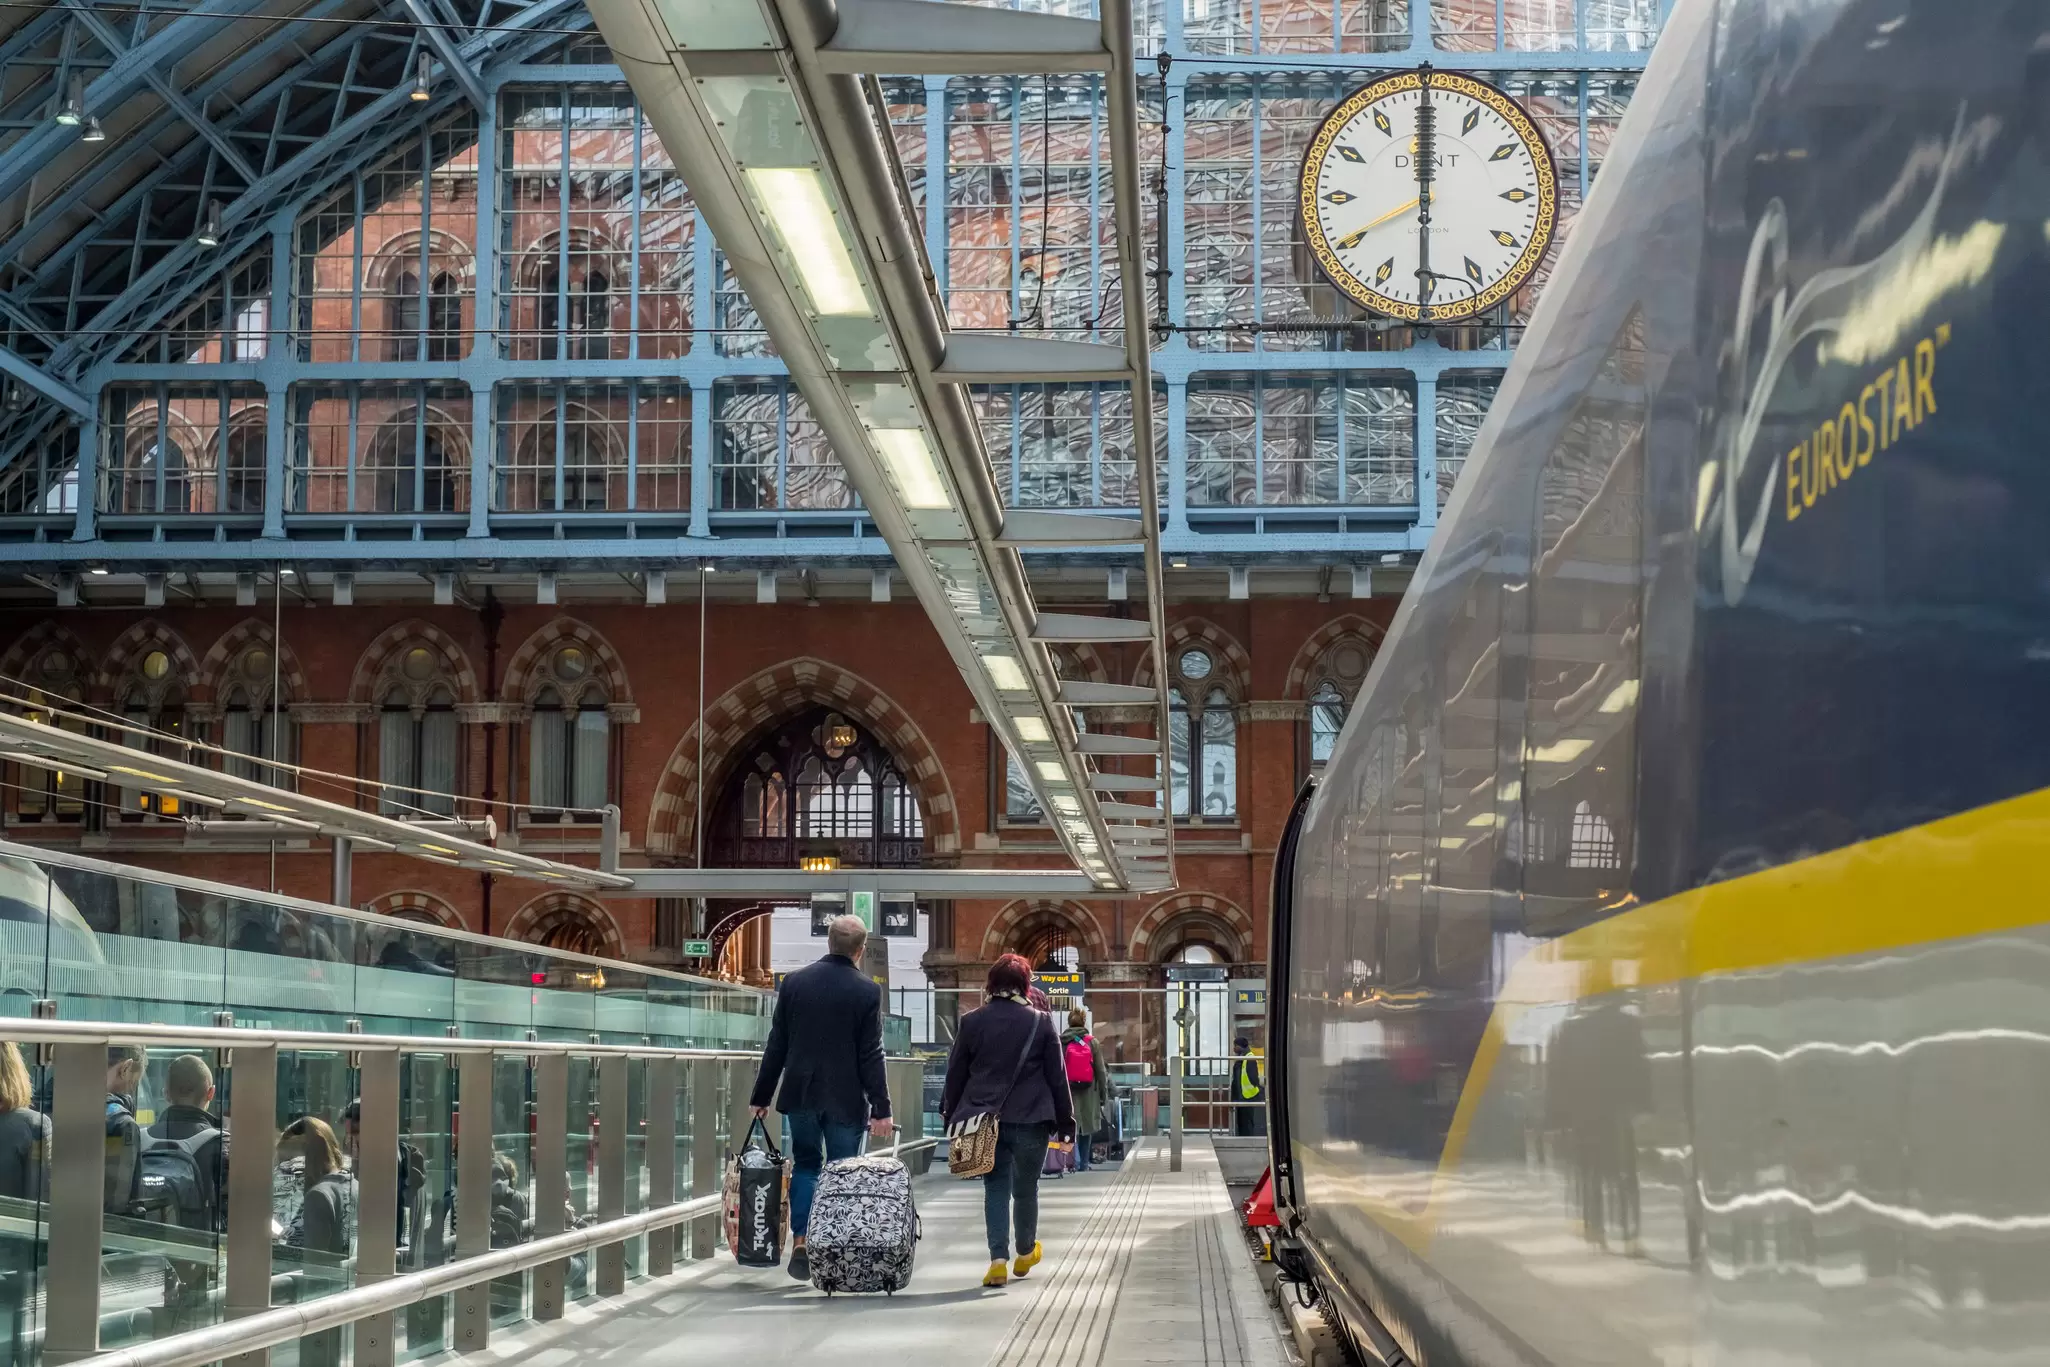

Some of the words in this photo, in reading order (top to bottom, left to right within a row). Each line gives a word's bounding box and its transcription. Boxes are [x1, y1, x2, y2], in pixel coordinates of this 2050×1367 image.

[1041, 974, 1056, 984] Way
[1057, 975, 1069, 983] out
[1048, 986, 1070, 995] Sortie
